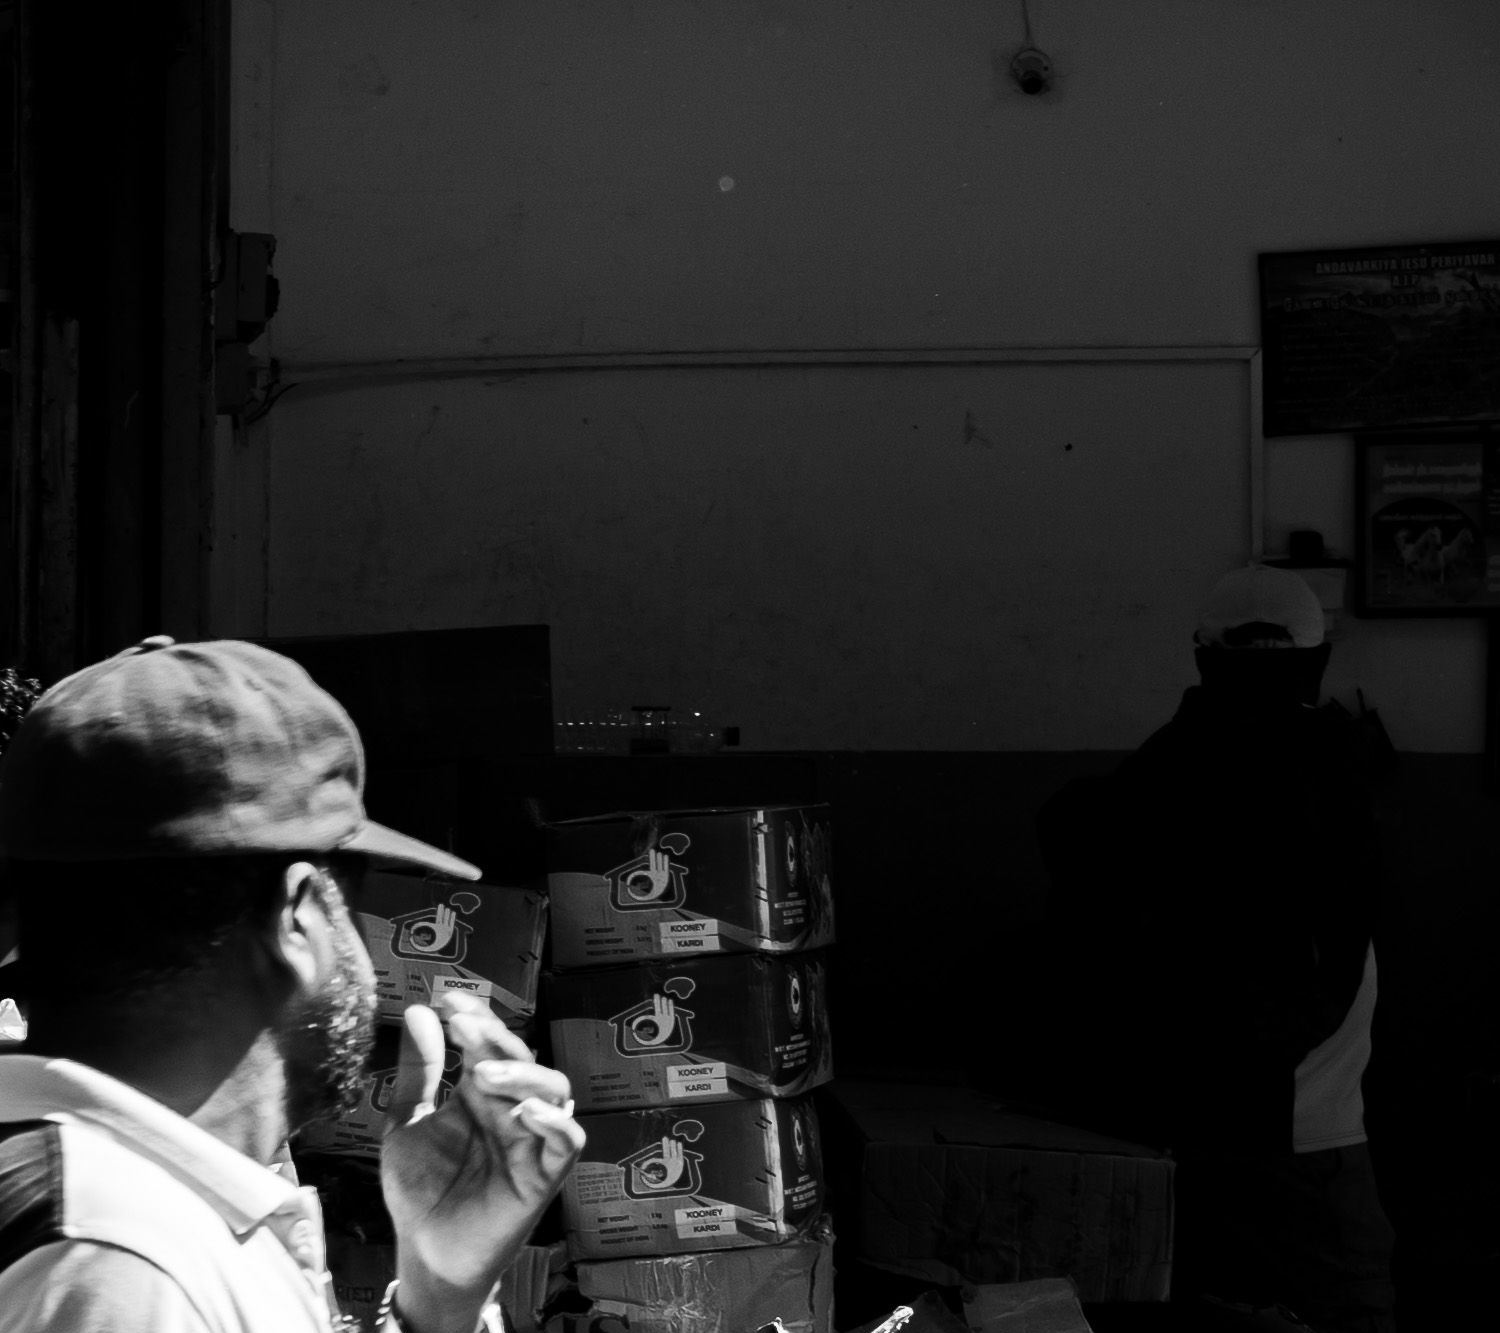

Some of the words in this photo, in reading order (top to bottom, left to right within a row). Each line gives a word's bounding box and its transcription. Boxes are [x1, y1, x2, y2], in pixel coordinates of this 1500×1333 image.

[670, 922, 706, 934] KOONEY
[677, 938, 703, 948] KARDI
[444, 979, 480, 991] KOONEY
[678, 1066, 714, 1077] KOONEY
[685, 1083, 712, 1093] KARDI
[686, 1208, 722, 1219] KOONEY
[693, 1224, 720, 1233] KARDI
